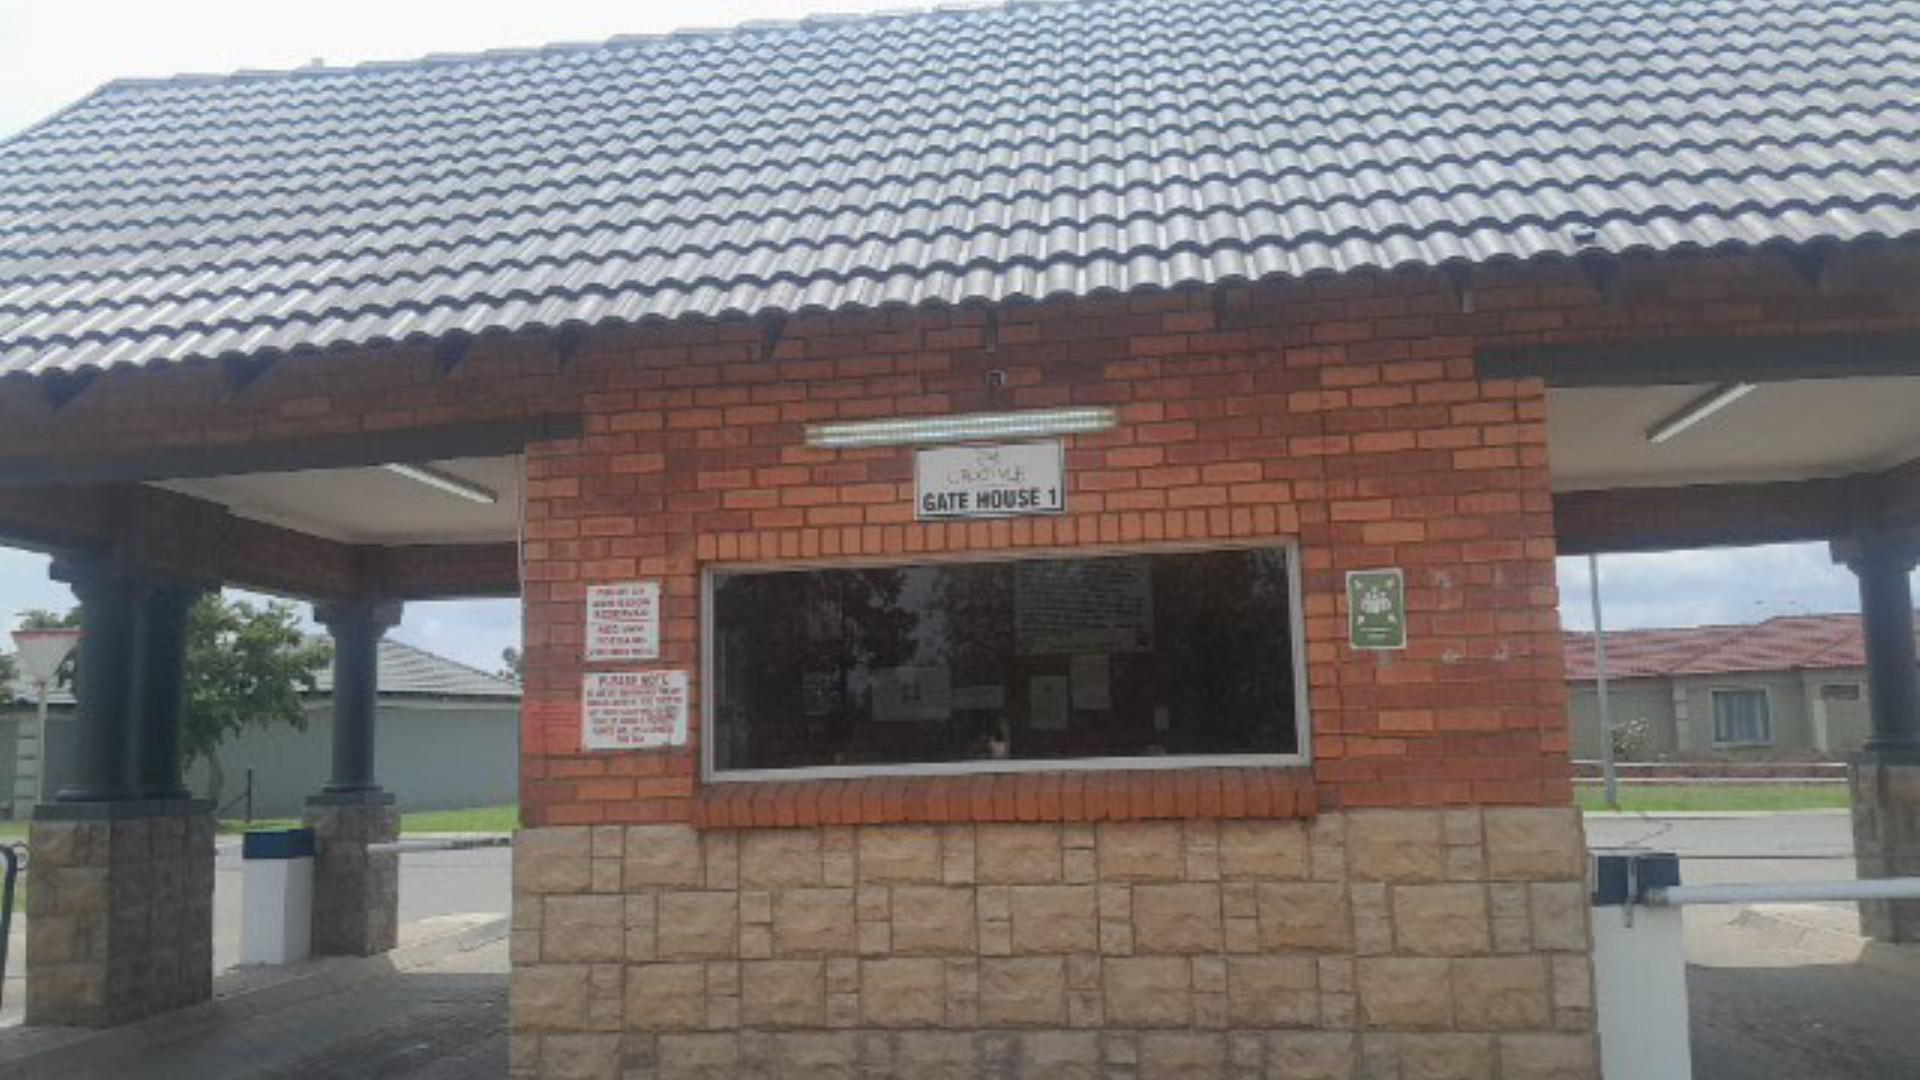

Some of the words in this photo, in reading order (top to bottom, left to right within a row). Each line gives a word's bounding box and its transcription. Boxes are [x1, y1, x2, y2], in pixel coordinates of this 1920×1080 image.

[922, 491, 969, 512] GATE
[976, 487, 1041, 509] HOUSE
[1048, 487, 1056, 505] 1
